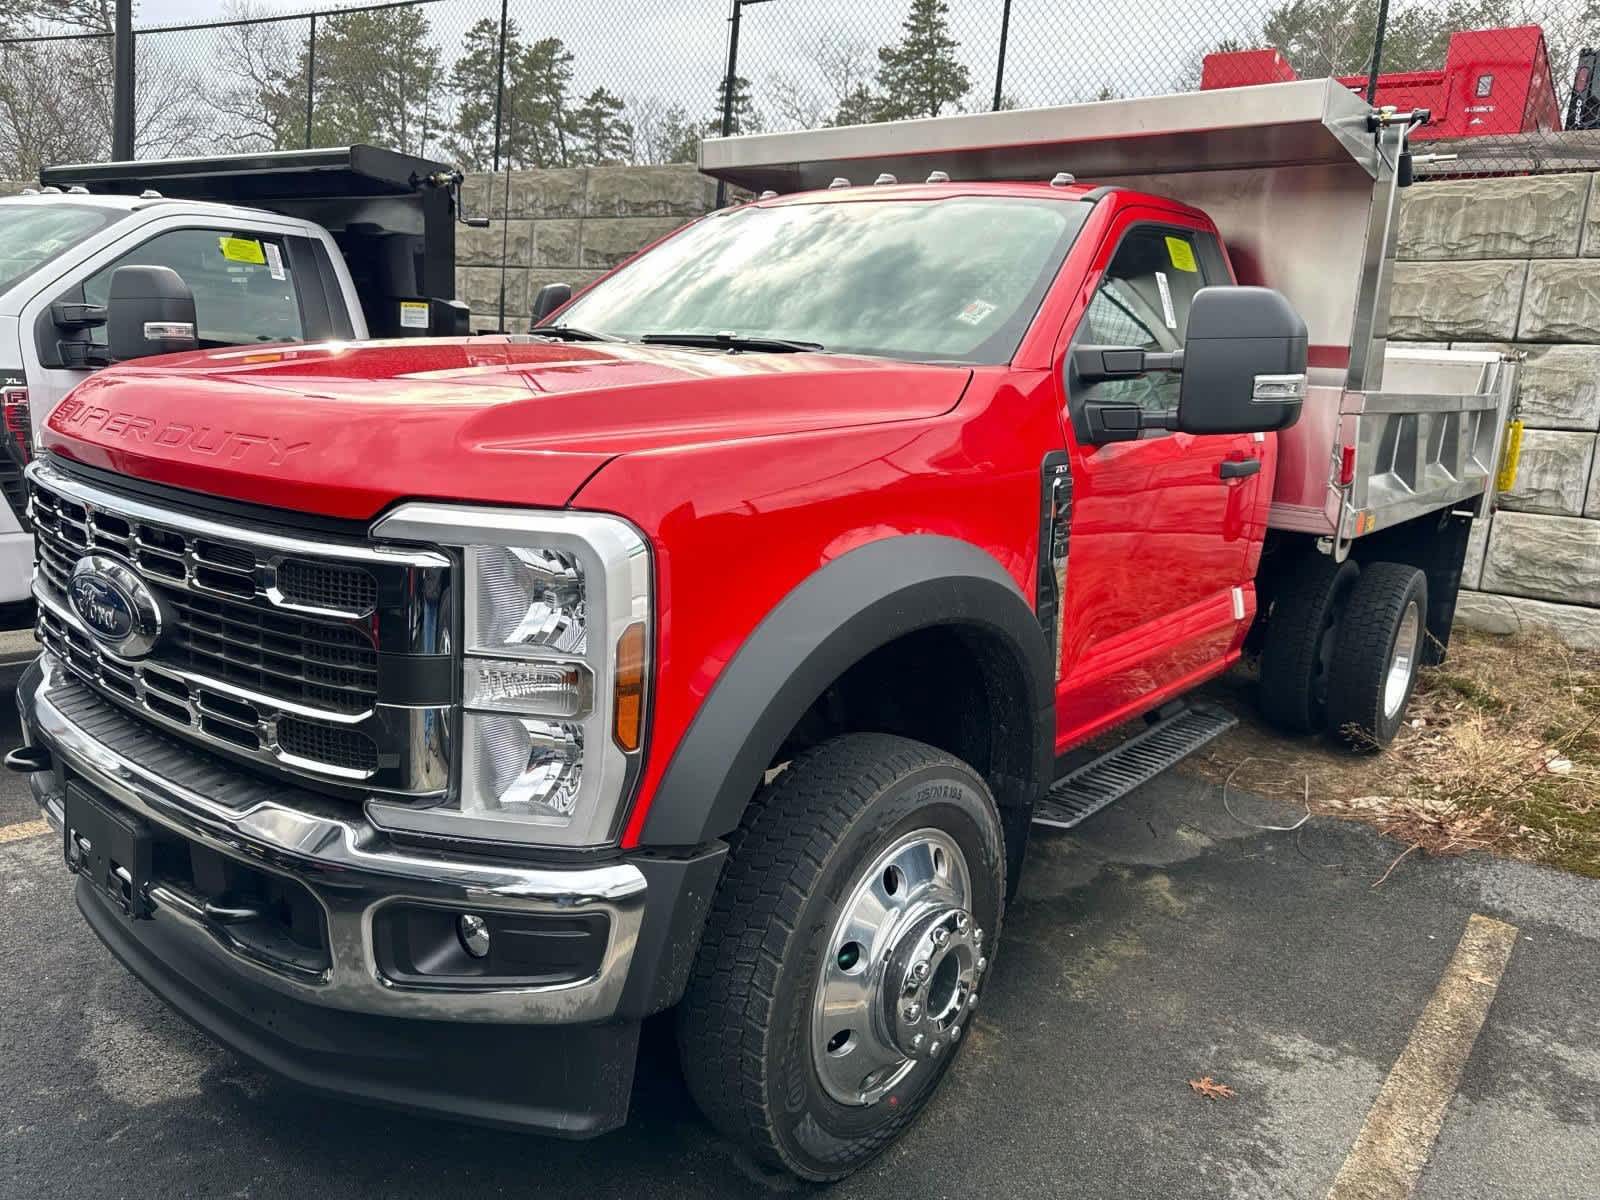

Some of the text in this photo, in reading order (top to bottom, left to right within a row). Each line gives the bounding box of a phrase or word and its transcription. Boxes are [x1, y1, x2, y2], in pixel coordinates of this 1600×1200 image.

[53, 400, 156, 442] SUPER
[154, 423, 312, 466] DUTY
[75, 582, 118, 631] Ford
